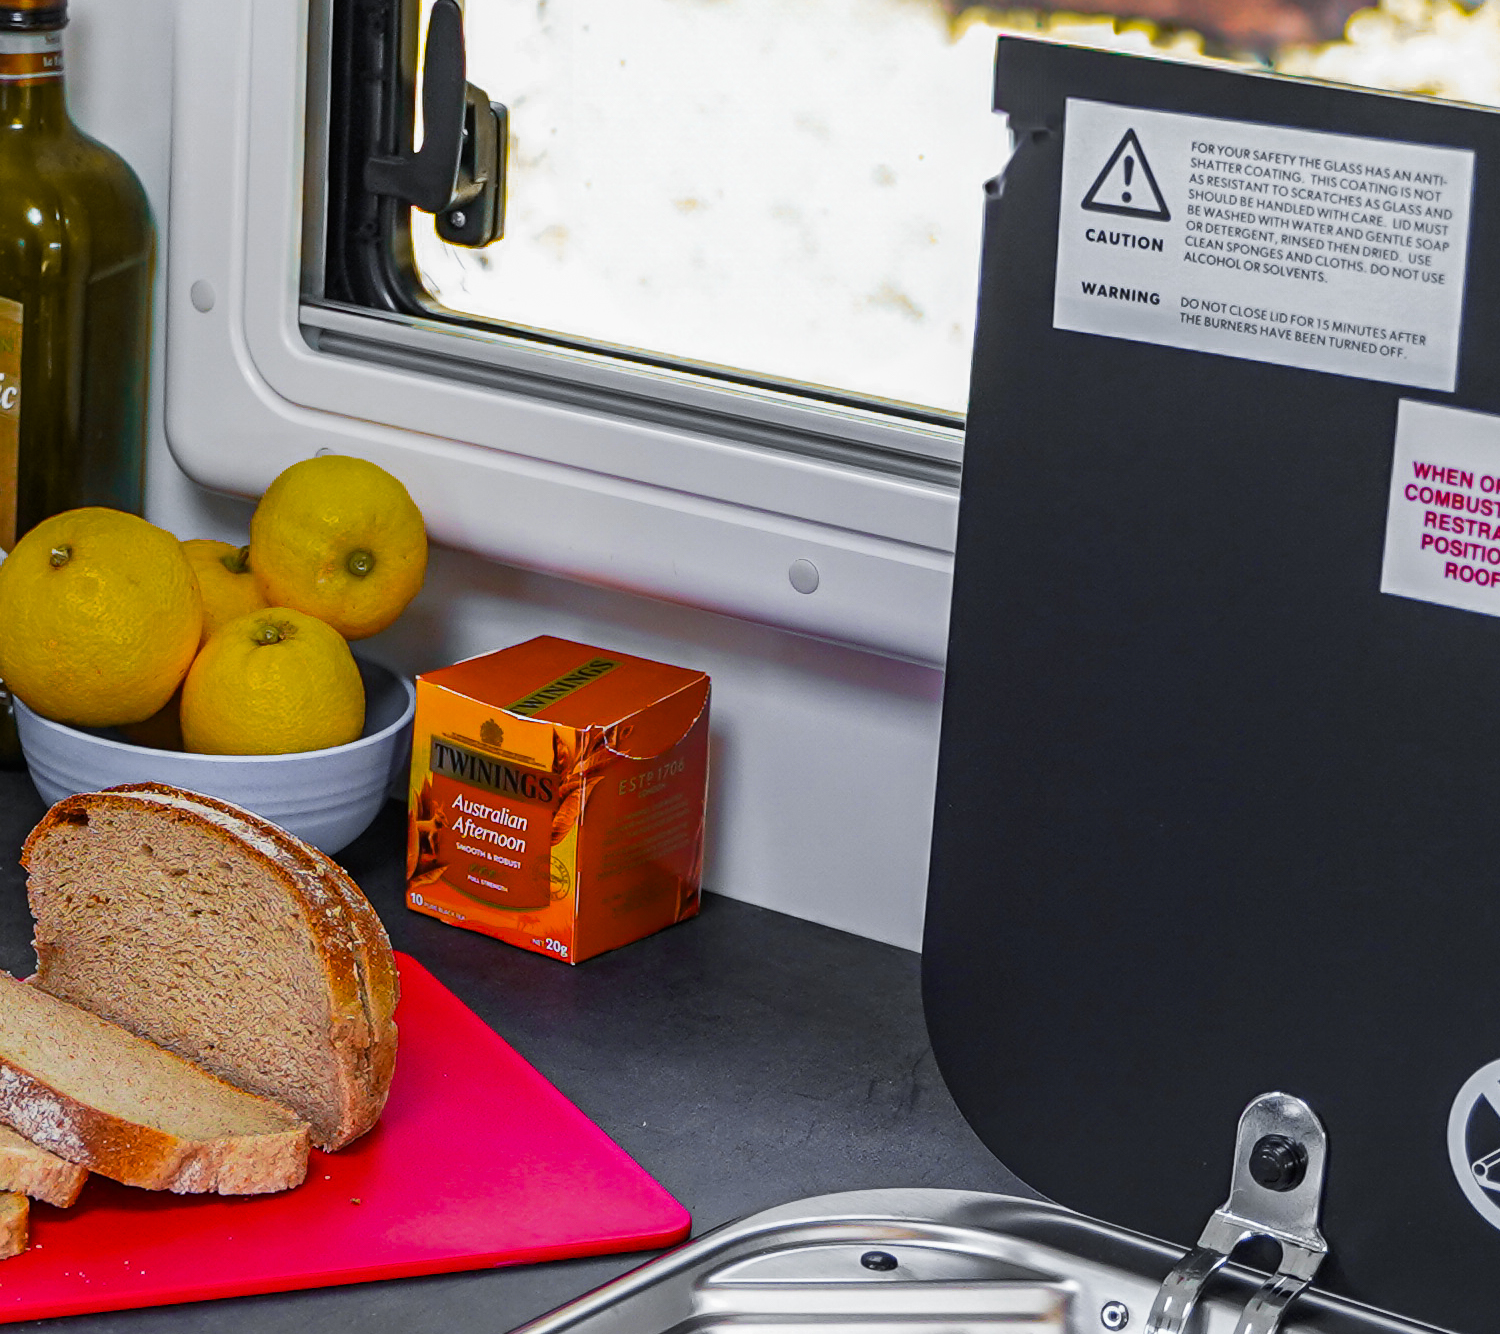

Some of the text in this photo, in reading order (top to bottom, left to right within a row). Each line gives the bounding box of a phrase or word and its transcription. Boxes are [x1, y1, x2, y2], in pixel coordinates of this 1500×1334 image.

[1190, 156, 1442, 203] SHATTER COATING. THIS COATING IS NOT
[1191, 141, 1448, 186] FOR YOUR SAFETY THE GLASS HAS AN ANTI-
[1188, 173, 1453, 221] AS RESISTANT TO SCRATCHES AS GLASS AND
[1188, 188, 1449, 236] SHOULD BE HANDLED WITH CARE. LID MUST
[1085, 228, 1164, 253] CAUTION
[1185, 219, 1432, 267] OR DETERGENT, RINSED THEN DRIED. USE
[1187, 204, 1450, 252] BE WASHED WITH WATER AND GENTLE SOAP
[1183, 251, 1328, 284] ALCOHOL OR SOLVENTS.
[1184, 235, 1445, 285] CLEAN SPONGES AND CLOTHS. DO NOT USE
[1081, 281, 1161, 306] WARNING
[1180, 296, 1427, 346] DO NOT CLOSE LID FOR 15 MINUTES AFTER
[1180, 311, 1404, 358] THE BURNERS HAVE BEEN TURNED OFF.
[1412, 460, 1475, 490] WHEN
[433, 741, 553, 804] TWININGS
[451, 793, 528, 832] Australian
[451, 816, 527, 854] Afternoon
[456, 841, 486, 859] SMOOTH
[493, 853, 522, 869] ROBUST
[410, 892, 424, 906] 10
[545, 937, 569, 958] 20g
